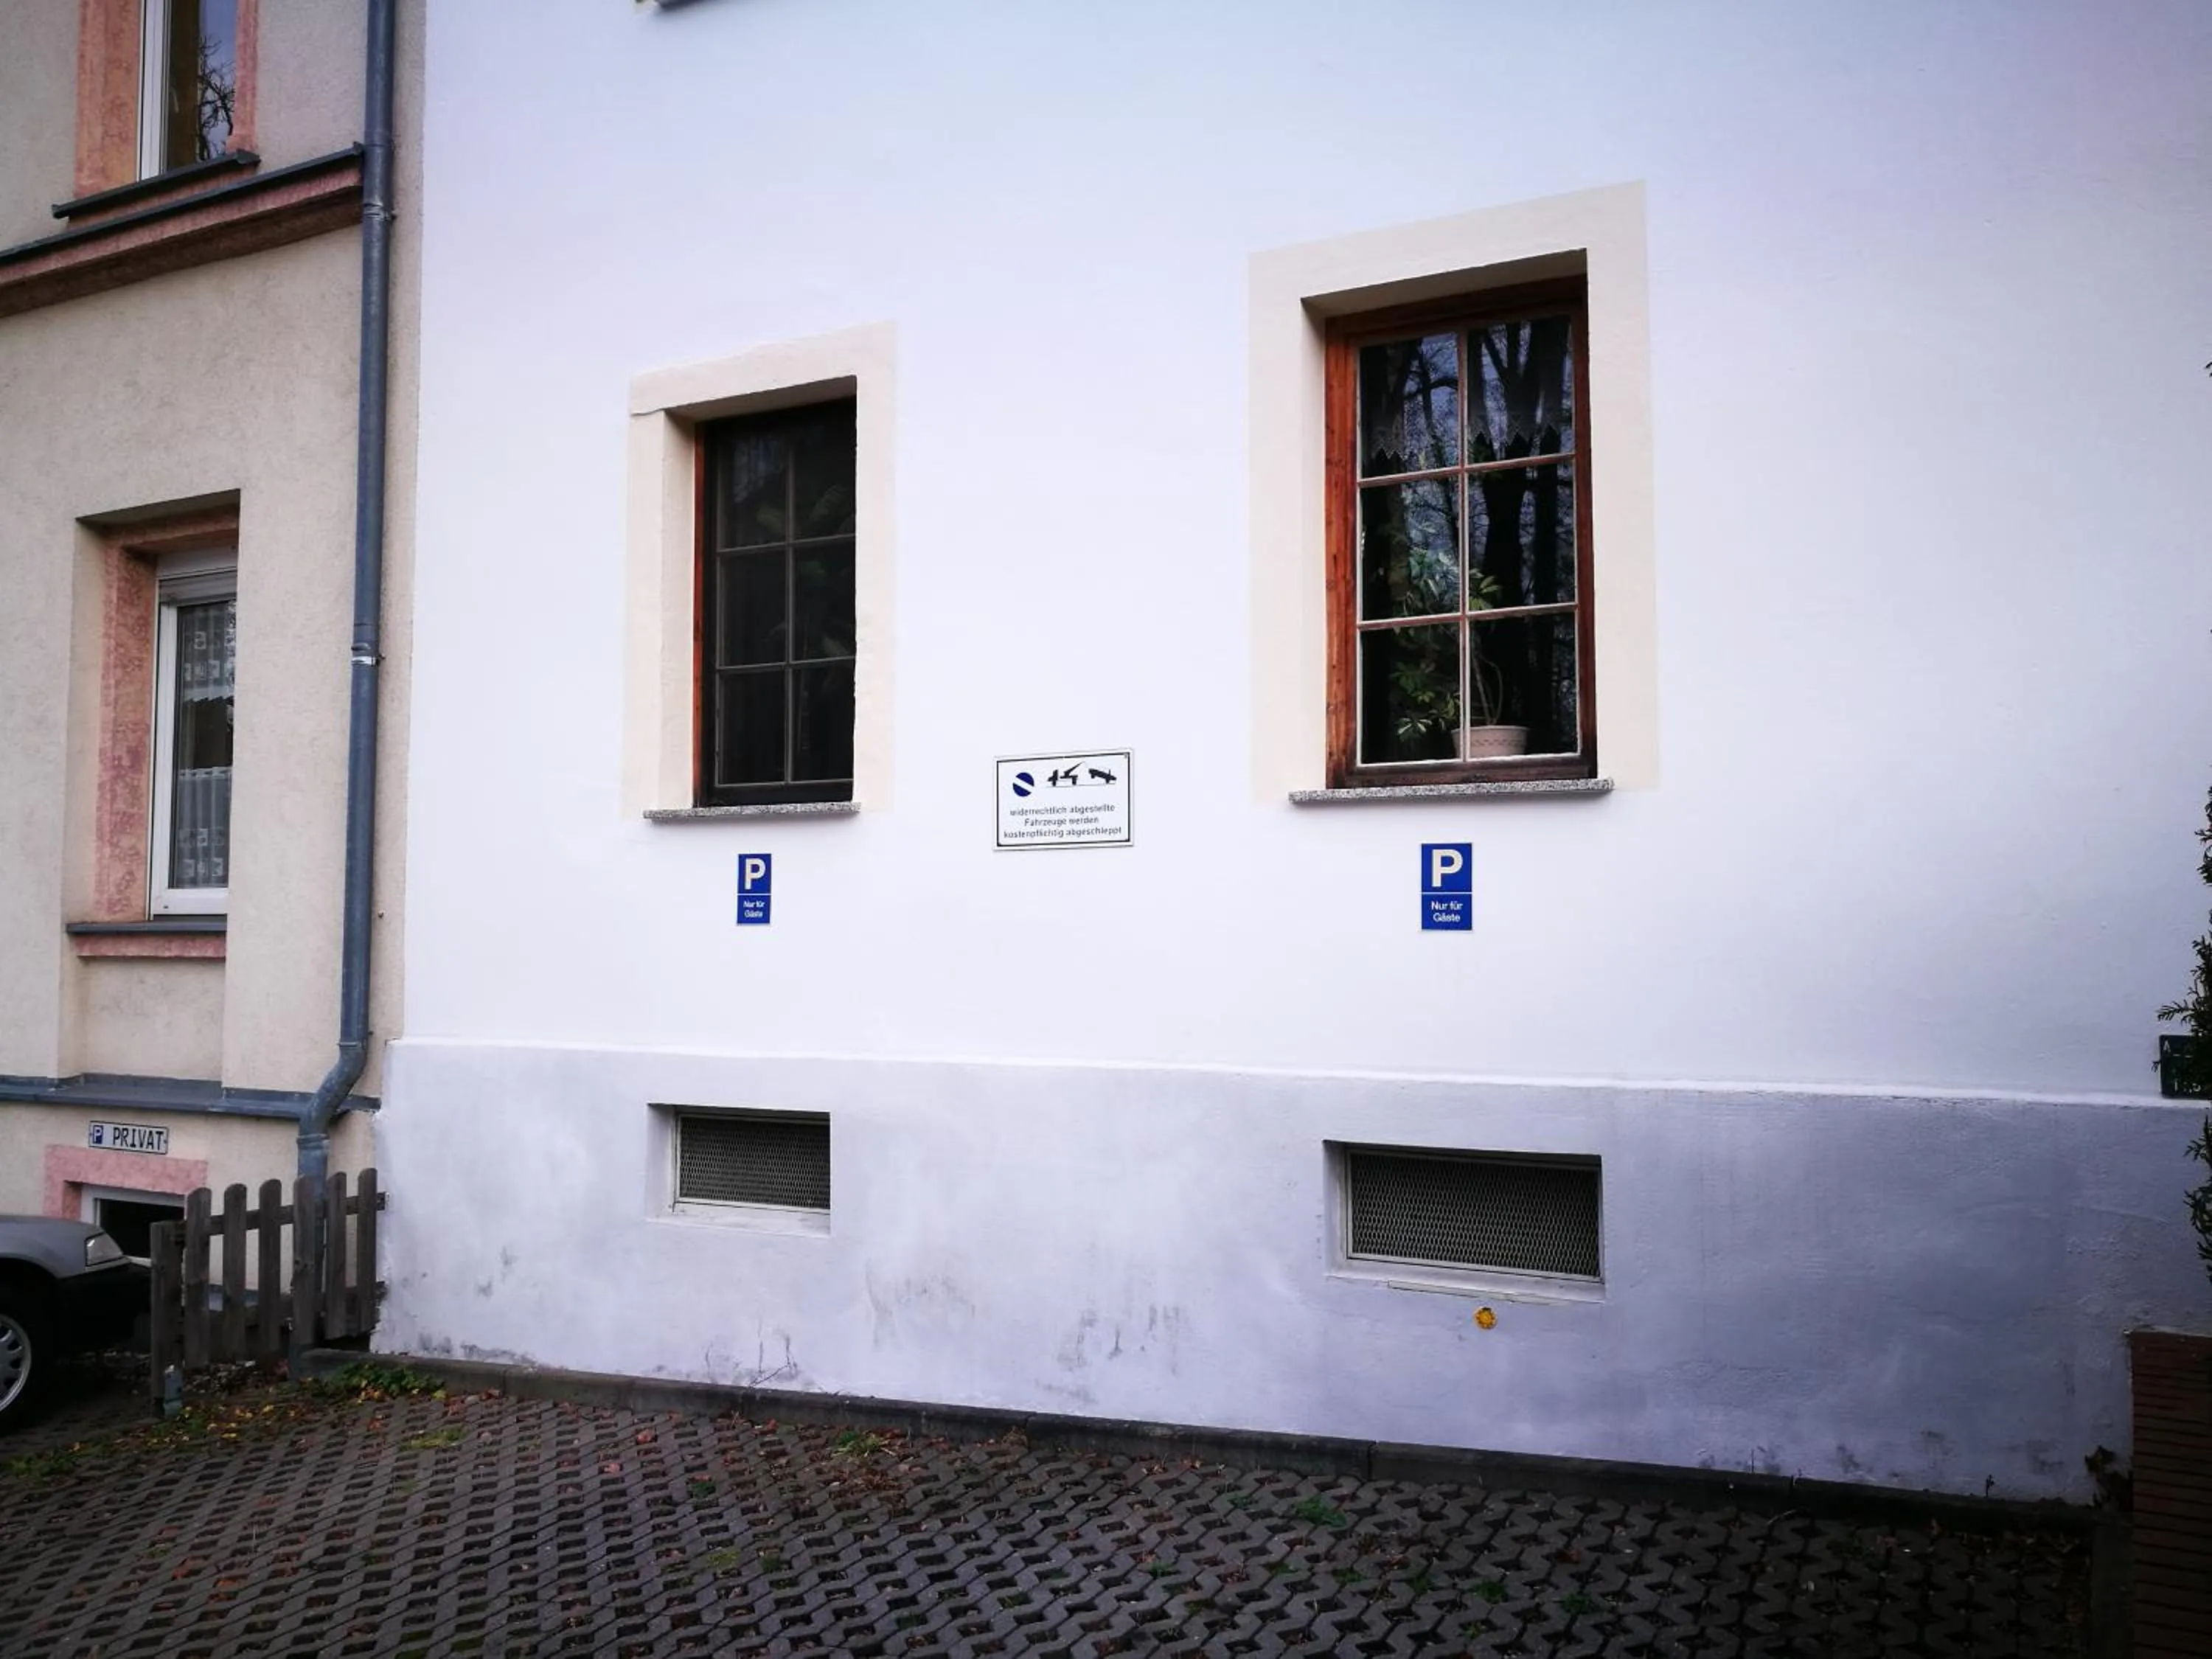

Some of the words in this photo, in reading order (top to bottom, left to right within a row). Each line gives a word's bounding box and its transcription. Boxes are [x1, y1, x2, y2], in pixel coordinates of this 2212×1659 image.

[1009, 805, 1067, 816] widerrechtlich
[1069, 804, 1116, 815] abgestellte
[1024, 816, 1067, 827] Fahrzeuge
[1068, 815, 1099, 825] werden
[1065, 826, 1121, 838] abgeschleppt
[745, 858, 766, 890] P
[1432, 849, 1464, 887] P
[1431, 900, 1447, 911] Nur
[1450, 900, 1463, 911] für
[1433, 912, 1461, 922] Gäste
[113, 1127, 164, 1151] PRIVAT
